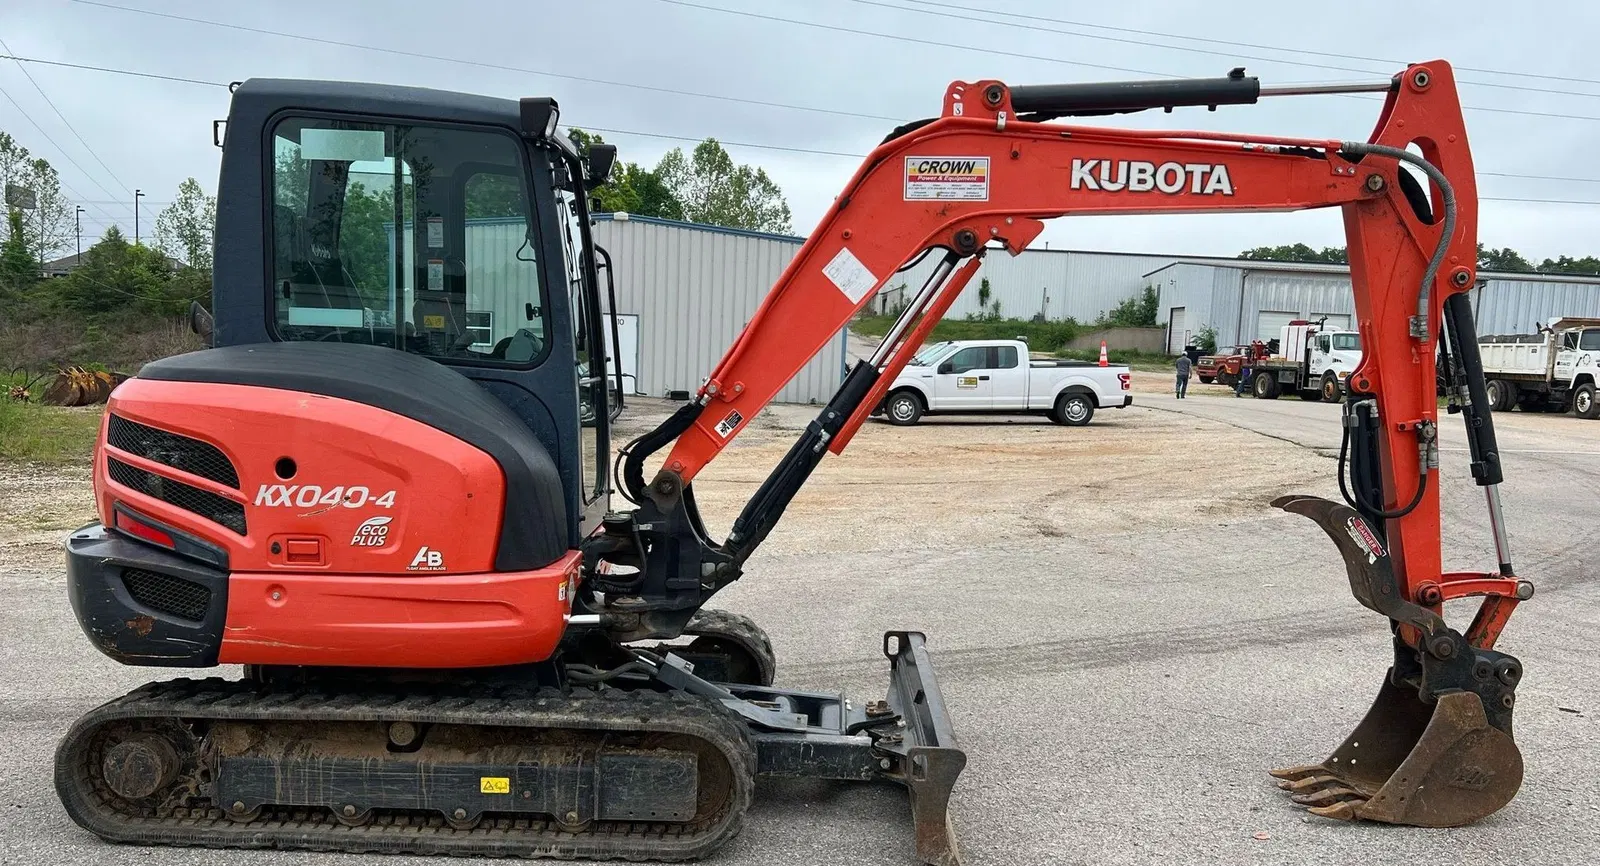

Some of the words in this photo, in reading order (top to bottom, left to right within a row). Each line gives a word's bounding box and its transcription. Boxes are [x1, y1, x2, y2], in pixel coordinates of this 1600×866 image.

[918, 160, 976, 174] CROWN
[1069, 158, 1235, 197] KUBOTA
[254, 484, 397, 509] KX040-4
[361, 525, 389, 536] eco
[1358, 525, 1377, 548] DANGER
[350, 535, 386, 547] PLUS
